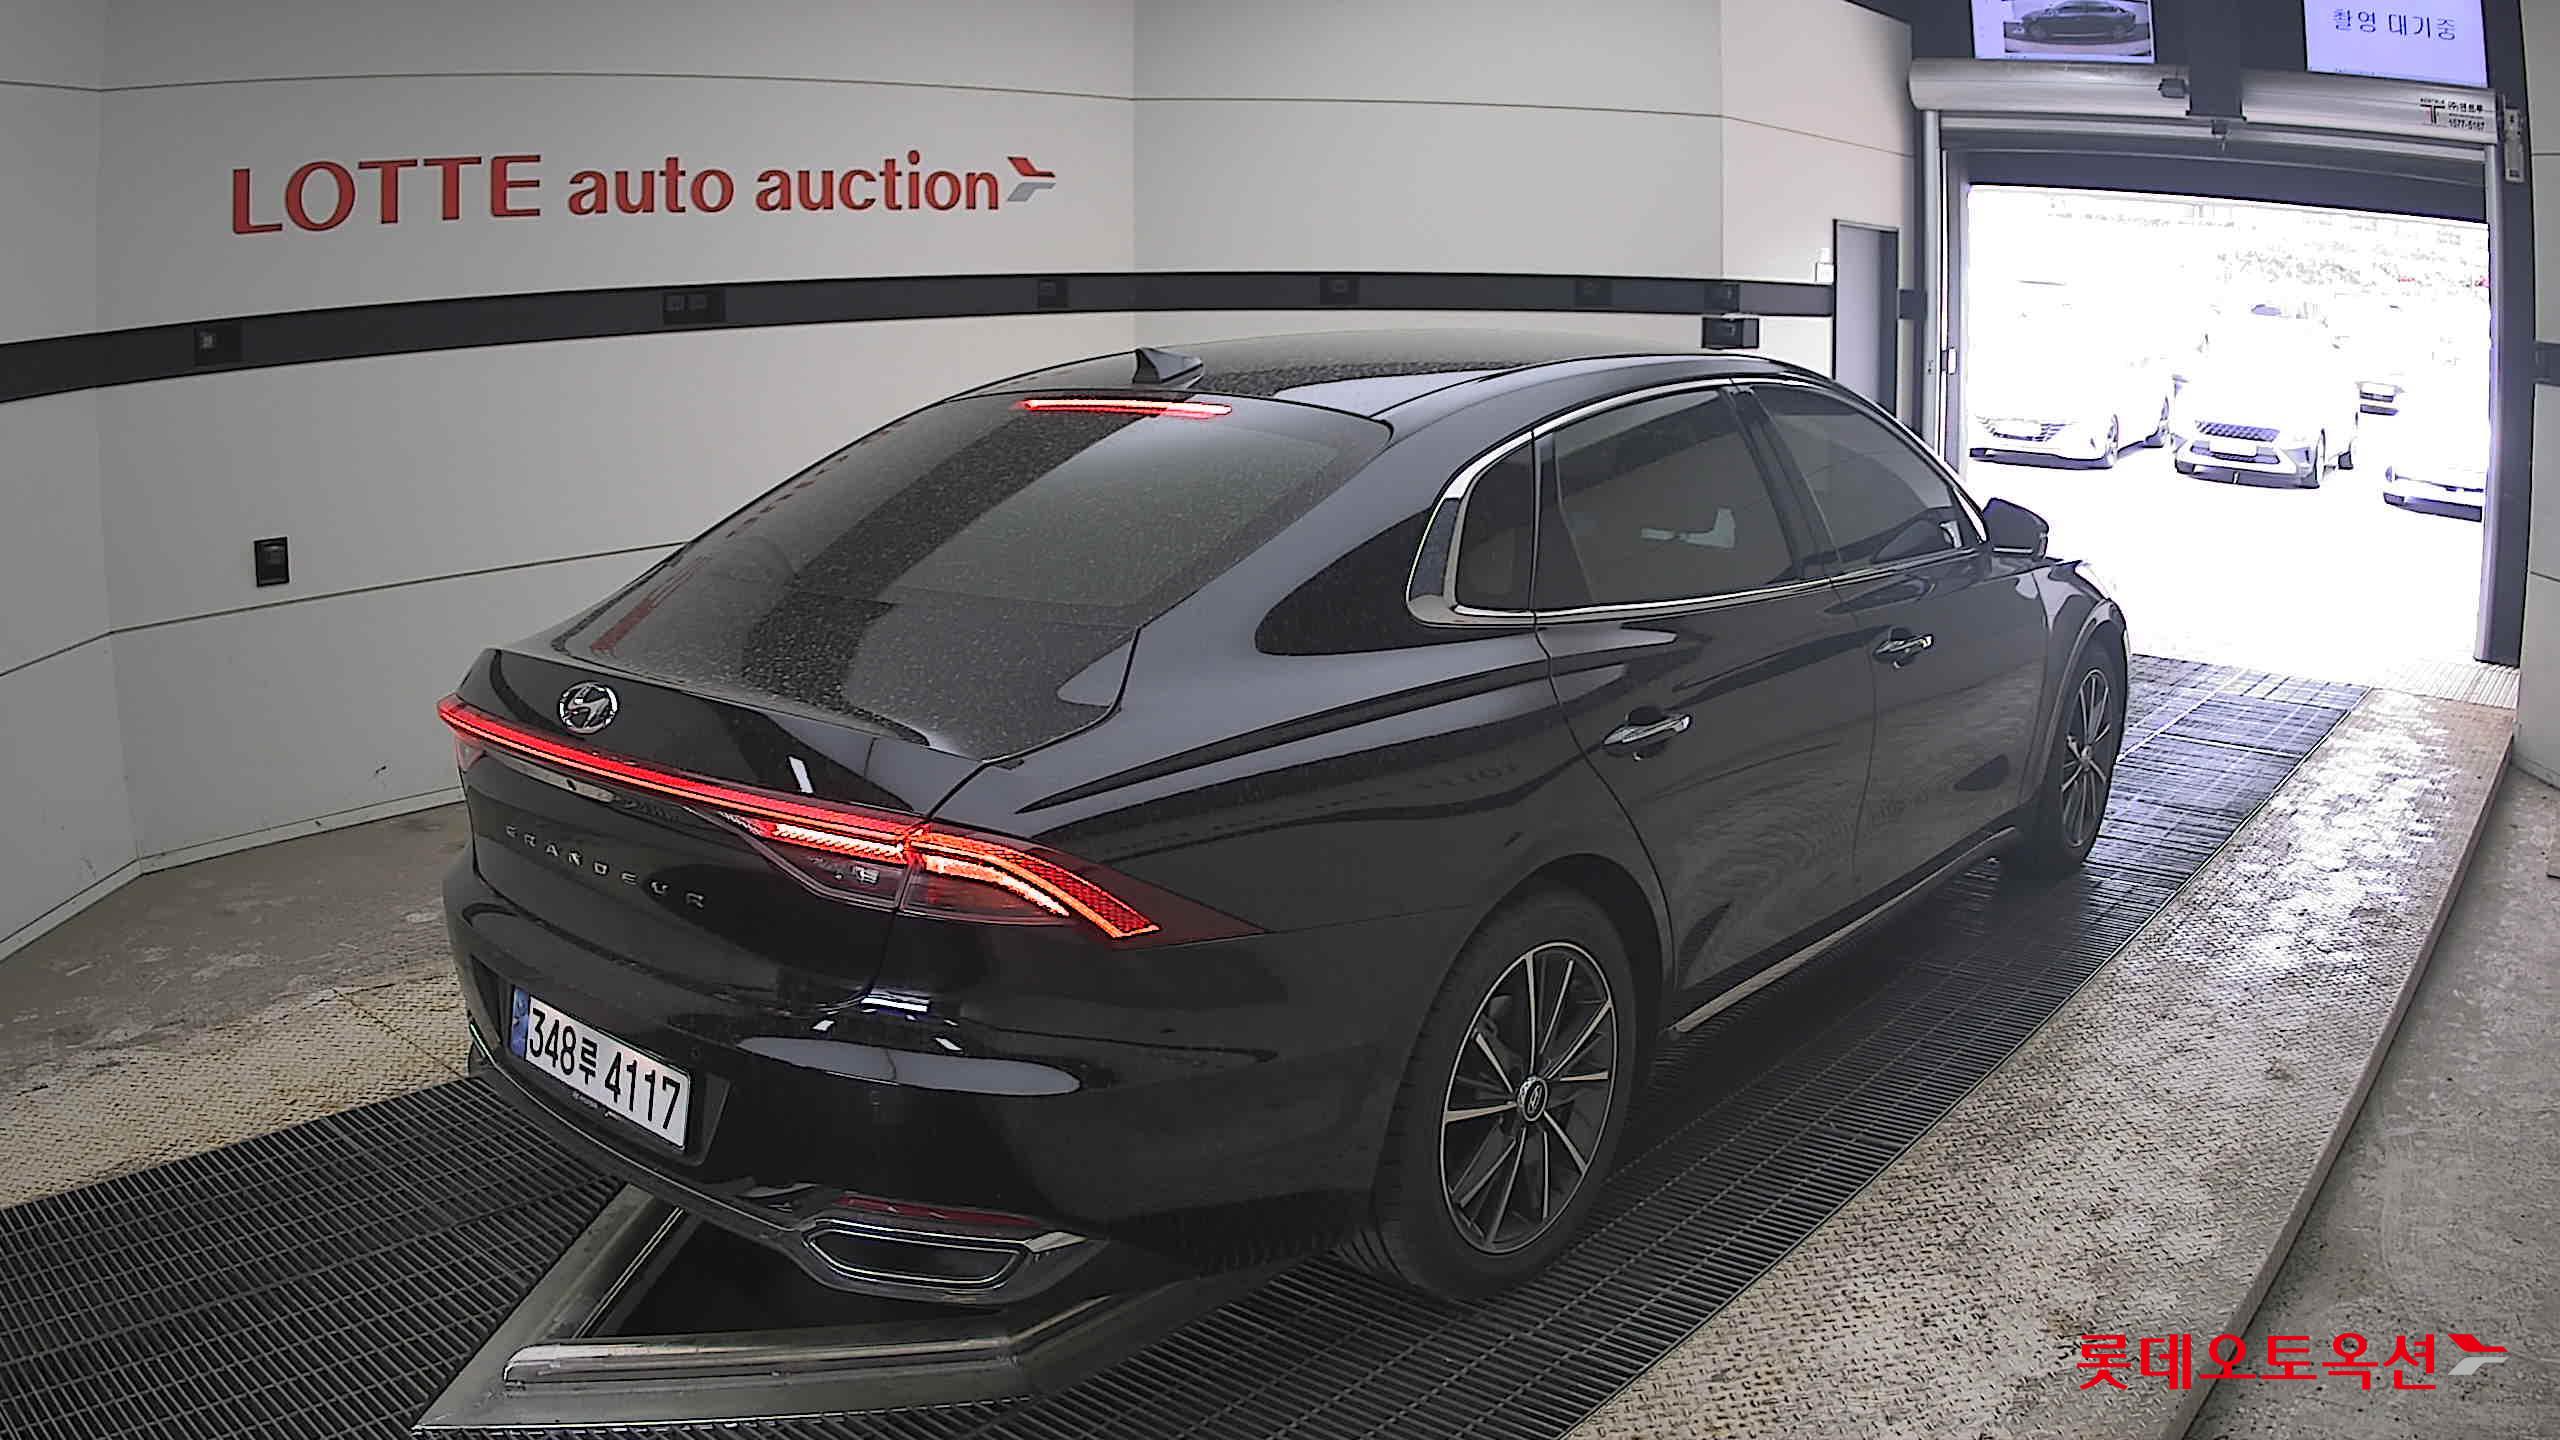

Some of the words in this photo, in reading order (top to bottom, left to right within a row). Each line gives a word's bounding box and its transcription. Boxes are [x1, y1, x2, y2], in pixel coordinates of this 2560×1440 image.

[2333, 9, 2376, 33] 촬영
[2388, 14, 2455, 41] 대기중
[233, 154, 541, 234] LOTTE
[568, 156, 734, 215] auto
[755, 150, 999, 212] auction
[529, 1007, 599, 1086] 348루
[604, 1051, 682, 1131] 4117
